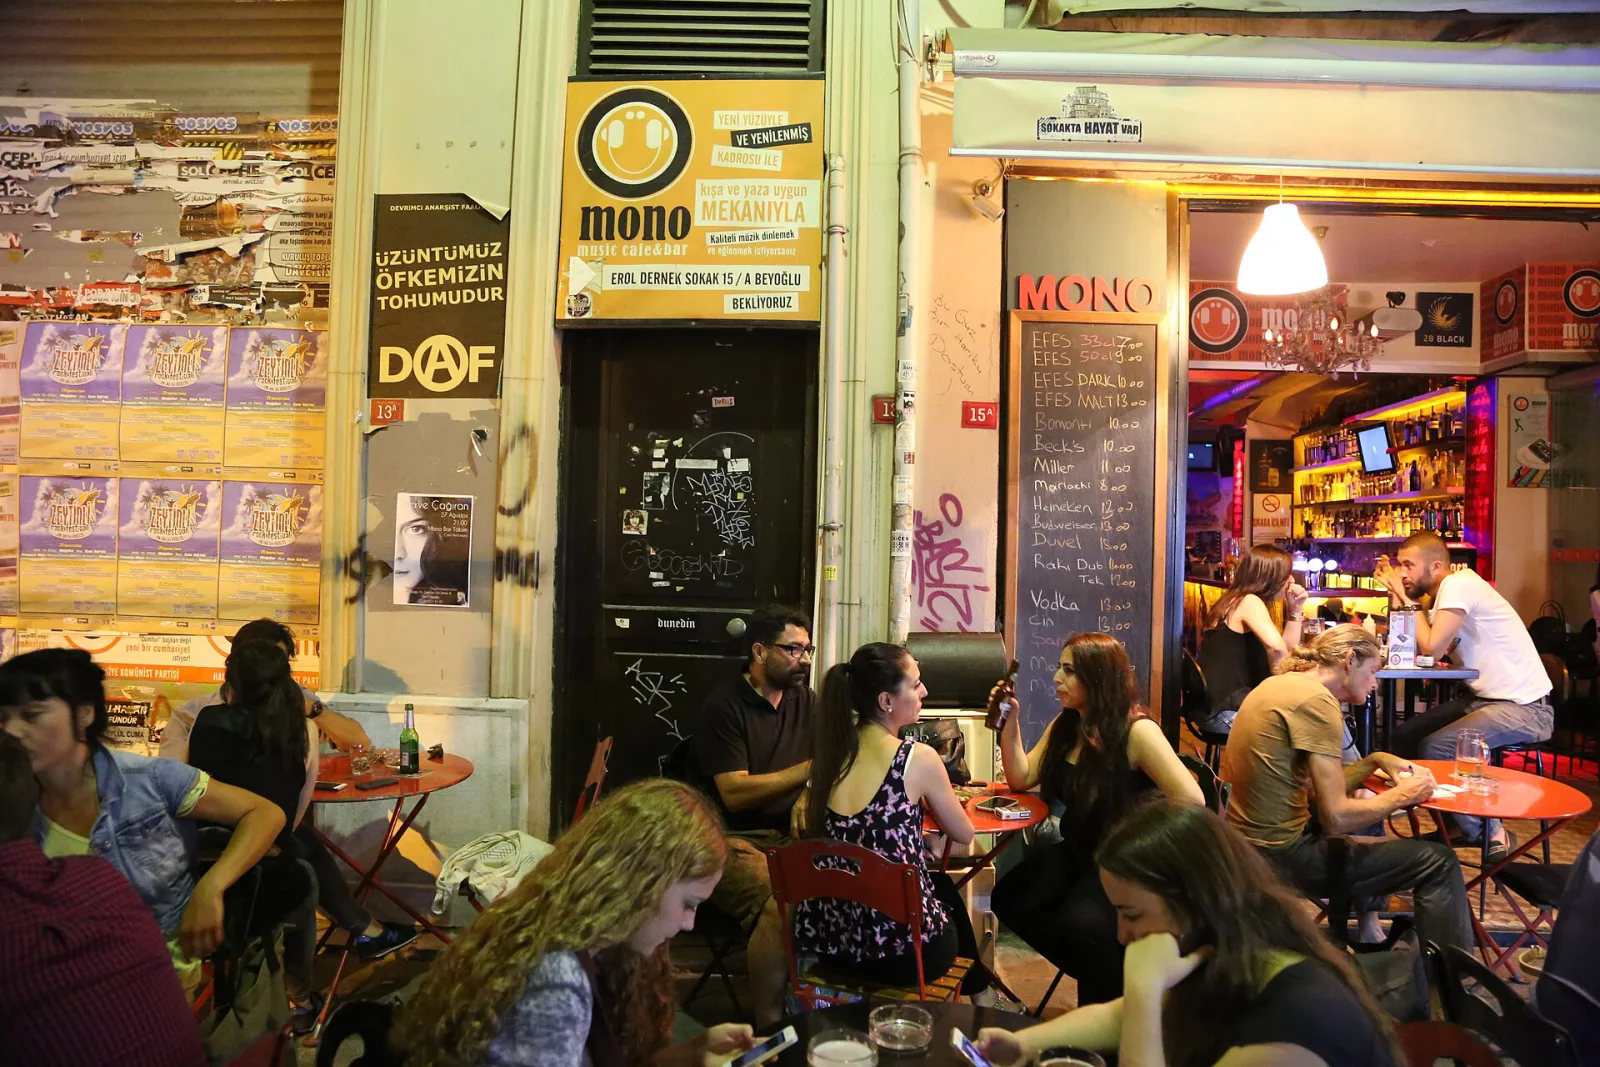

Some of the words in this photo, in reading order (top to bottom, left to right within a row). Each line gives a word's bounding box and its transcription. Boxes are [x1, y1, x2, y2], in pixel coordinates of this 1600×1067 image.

[719, 113, 740, 126] YENİ
[742, 113, 783, 126] YÜZÜYLE
[736, 132, 749, 146] VE
[750, 126, 809, 145] YENİLENMİŞ
[1041, 122, 1081, 134] SOKAKTA
[1084, 121, 1119, 135] HAYAT
[1121, 124, 1139, 135] VAR
[717, 150, 761, 165] KADROSU
[764, 151, 779, 167] İLE
[181, 166, 204, 177] SOL
[286, 167, 309, 177] SOL
[296, 194, 319, 203] daha
[700, 184, 723, 199] kışa
[727, 185, 740, 196] ve
[744, 185, 769, 199] yaza
[774, 185, 808, 200] uygun
[390, 204, 424, 212] DEVRİMCİ
[425, 203, 459, 212] ANARŞİST
[701, 201, 806, 223] MEKANIYLA
[579, 205, 691, 241] mono
[710, 232, 737, 244] Kaliteli
[738, 231, 760, 242] müzik
[761, 230, 795, 241] dinlemek
[281, 252, 311, 263] KURULUŞ
[375, 242, 502, 267] ÜZÜNTÜMÜZ
[577, 243, 617, 256] music
[622, 243, 688, 256] cafe&bar
[707, 247, 717, 255] ve
[718, 246, 752, 257] eğlenmek
[754, 246, 797, 256] istiyorsanız
[376, 263, 504, 290] ÖFKEMİZİN
[611, 272, 636, 285] EROL
[640, 272, 682, 285] DERNEK
[685, 272, 719, 285] SOKAK
[722, 272, 734, 285] 15
[744, 272, 751, 285] A
[754, 270, 801, 286] BEYOĞLU
[377, 286, 504, 310] TOHUMUDUR
[732, 293, 792, 310] BEKLİYORUZ
[1018, 274, 1160, 313] MONO
[1033, 331, 1071, 349] EFES
[1423, 334, 1434, 343] 28
[1436, 335, 1465, 343] BLACK
[1034, 351, 1071, 366] EFES
[1034, 372, 1073, 389] EFES
[1078, 373, 1117, 388] DARK
[1035, 392, 1071, 407] EFES
[1077, 394, 1114, 410] MALT
[969, 407, 993, 422] 15A
[1035, 412, 1091, 431] Bomonti
[1109, 416, 1139, 429] 10.00
[1032, 434, 1084, 453] Beck's
[1103, 439, 1136, 453] 10.00
[1034, 457, 1075, 474] Miller
[1101, 457, 1131, 473] 11.00
[1034, 497, 1093, 515] Heineken
[1031, 533, 1082, 550] Duvel
[1078, 574, 1105, 586] Tek
[1031, 589, 1080, 611] Vodka
[657, 617, 696, 629] dunedin
[1029, 615, 1055, 627] Cin
[126, 644, 140, 652] yeni
[142, 644, 151, 652] bir
[153, 645, 191, 654] cumhuriyet
[120, 667, 153, 678] KOMÜNİST
[154, 668, 180, 680] PARTİSİ
